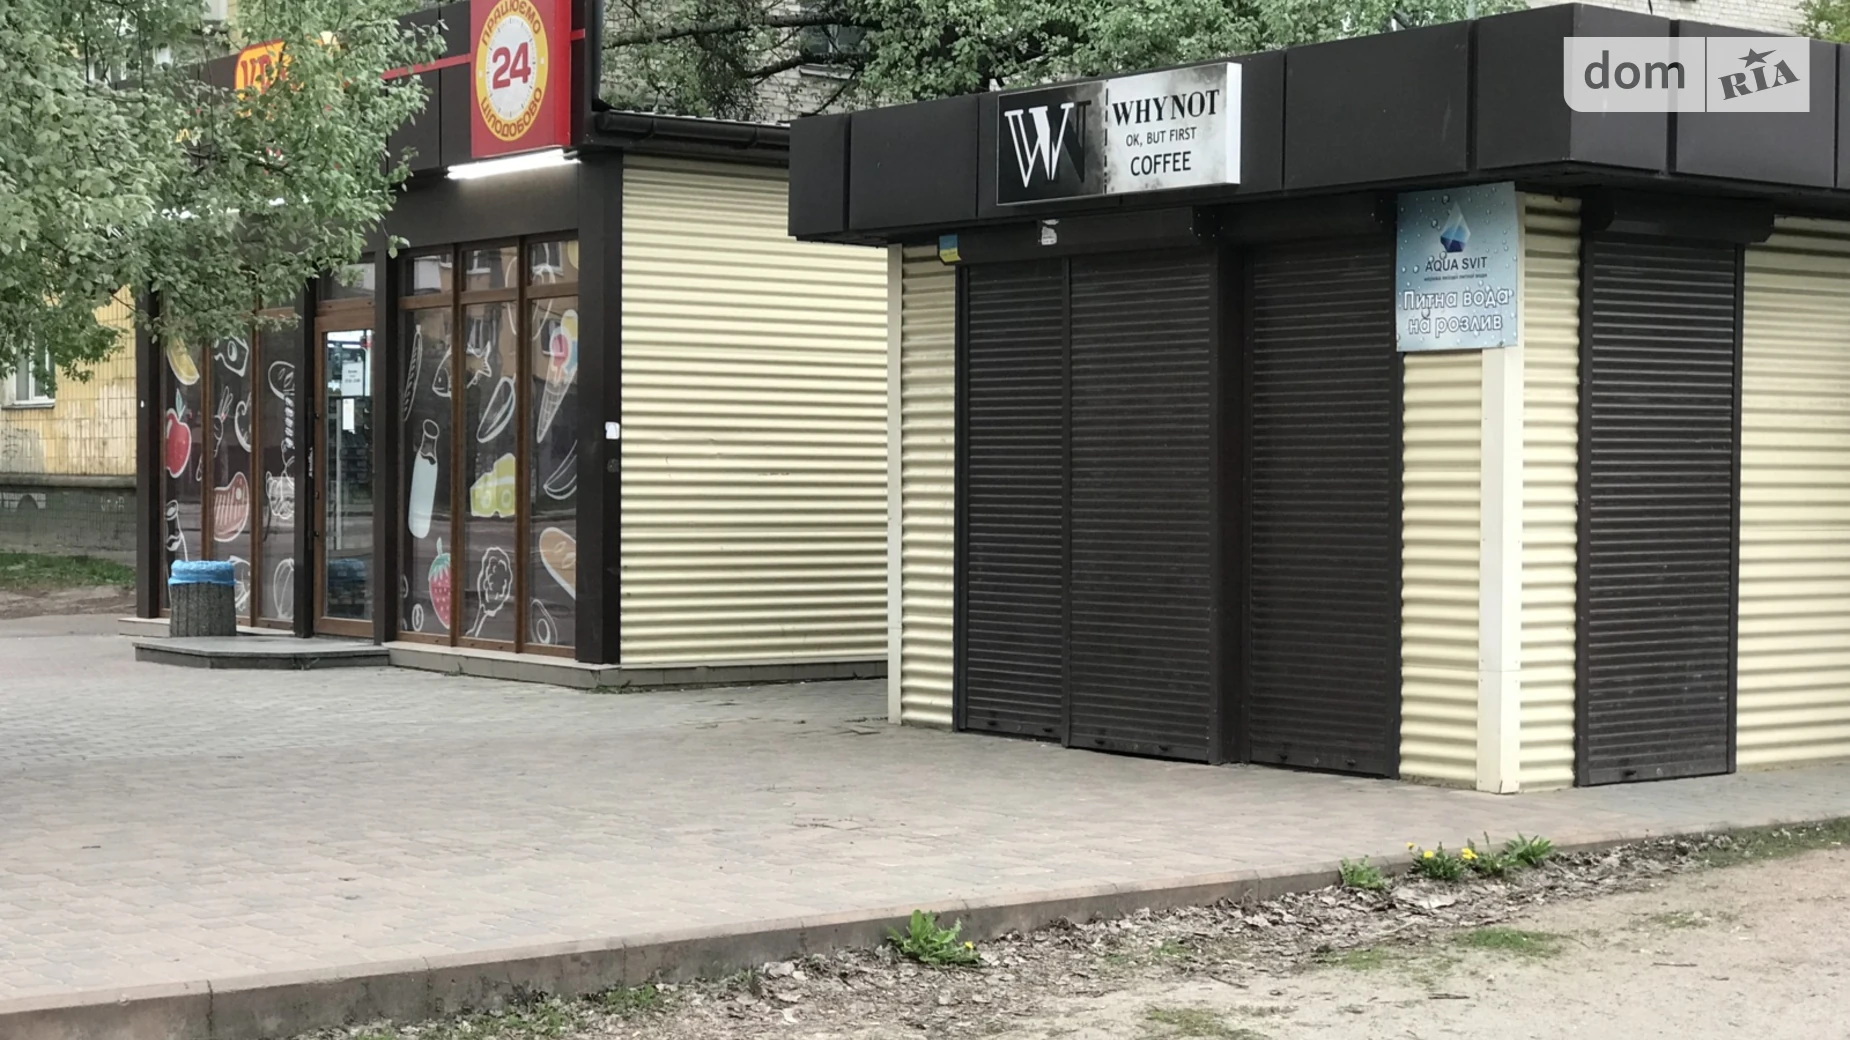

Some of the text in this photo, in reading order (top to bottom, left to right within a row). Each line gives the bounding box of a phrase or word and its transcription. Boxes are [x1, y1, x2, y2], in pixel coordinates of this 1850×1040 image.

[482, 0, 541, 46] ПРАЦЮЄМО
[492, 42, 532, 89] 24
[481, 87, 542, 137] ЦІЛОДОБОВО
[1112, 89, 1219, 126] WHY NOT
[1126, 127, 1197, 147] OK, BUT FIRST
[1130, 151, 1191, 176] COFFEE
[1425, 256, 1487, 272] AQUA SVIT
[1403, 289, 1510, 310] Питна вода
[1408, 315, 1503, 338] на розлив
